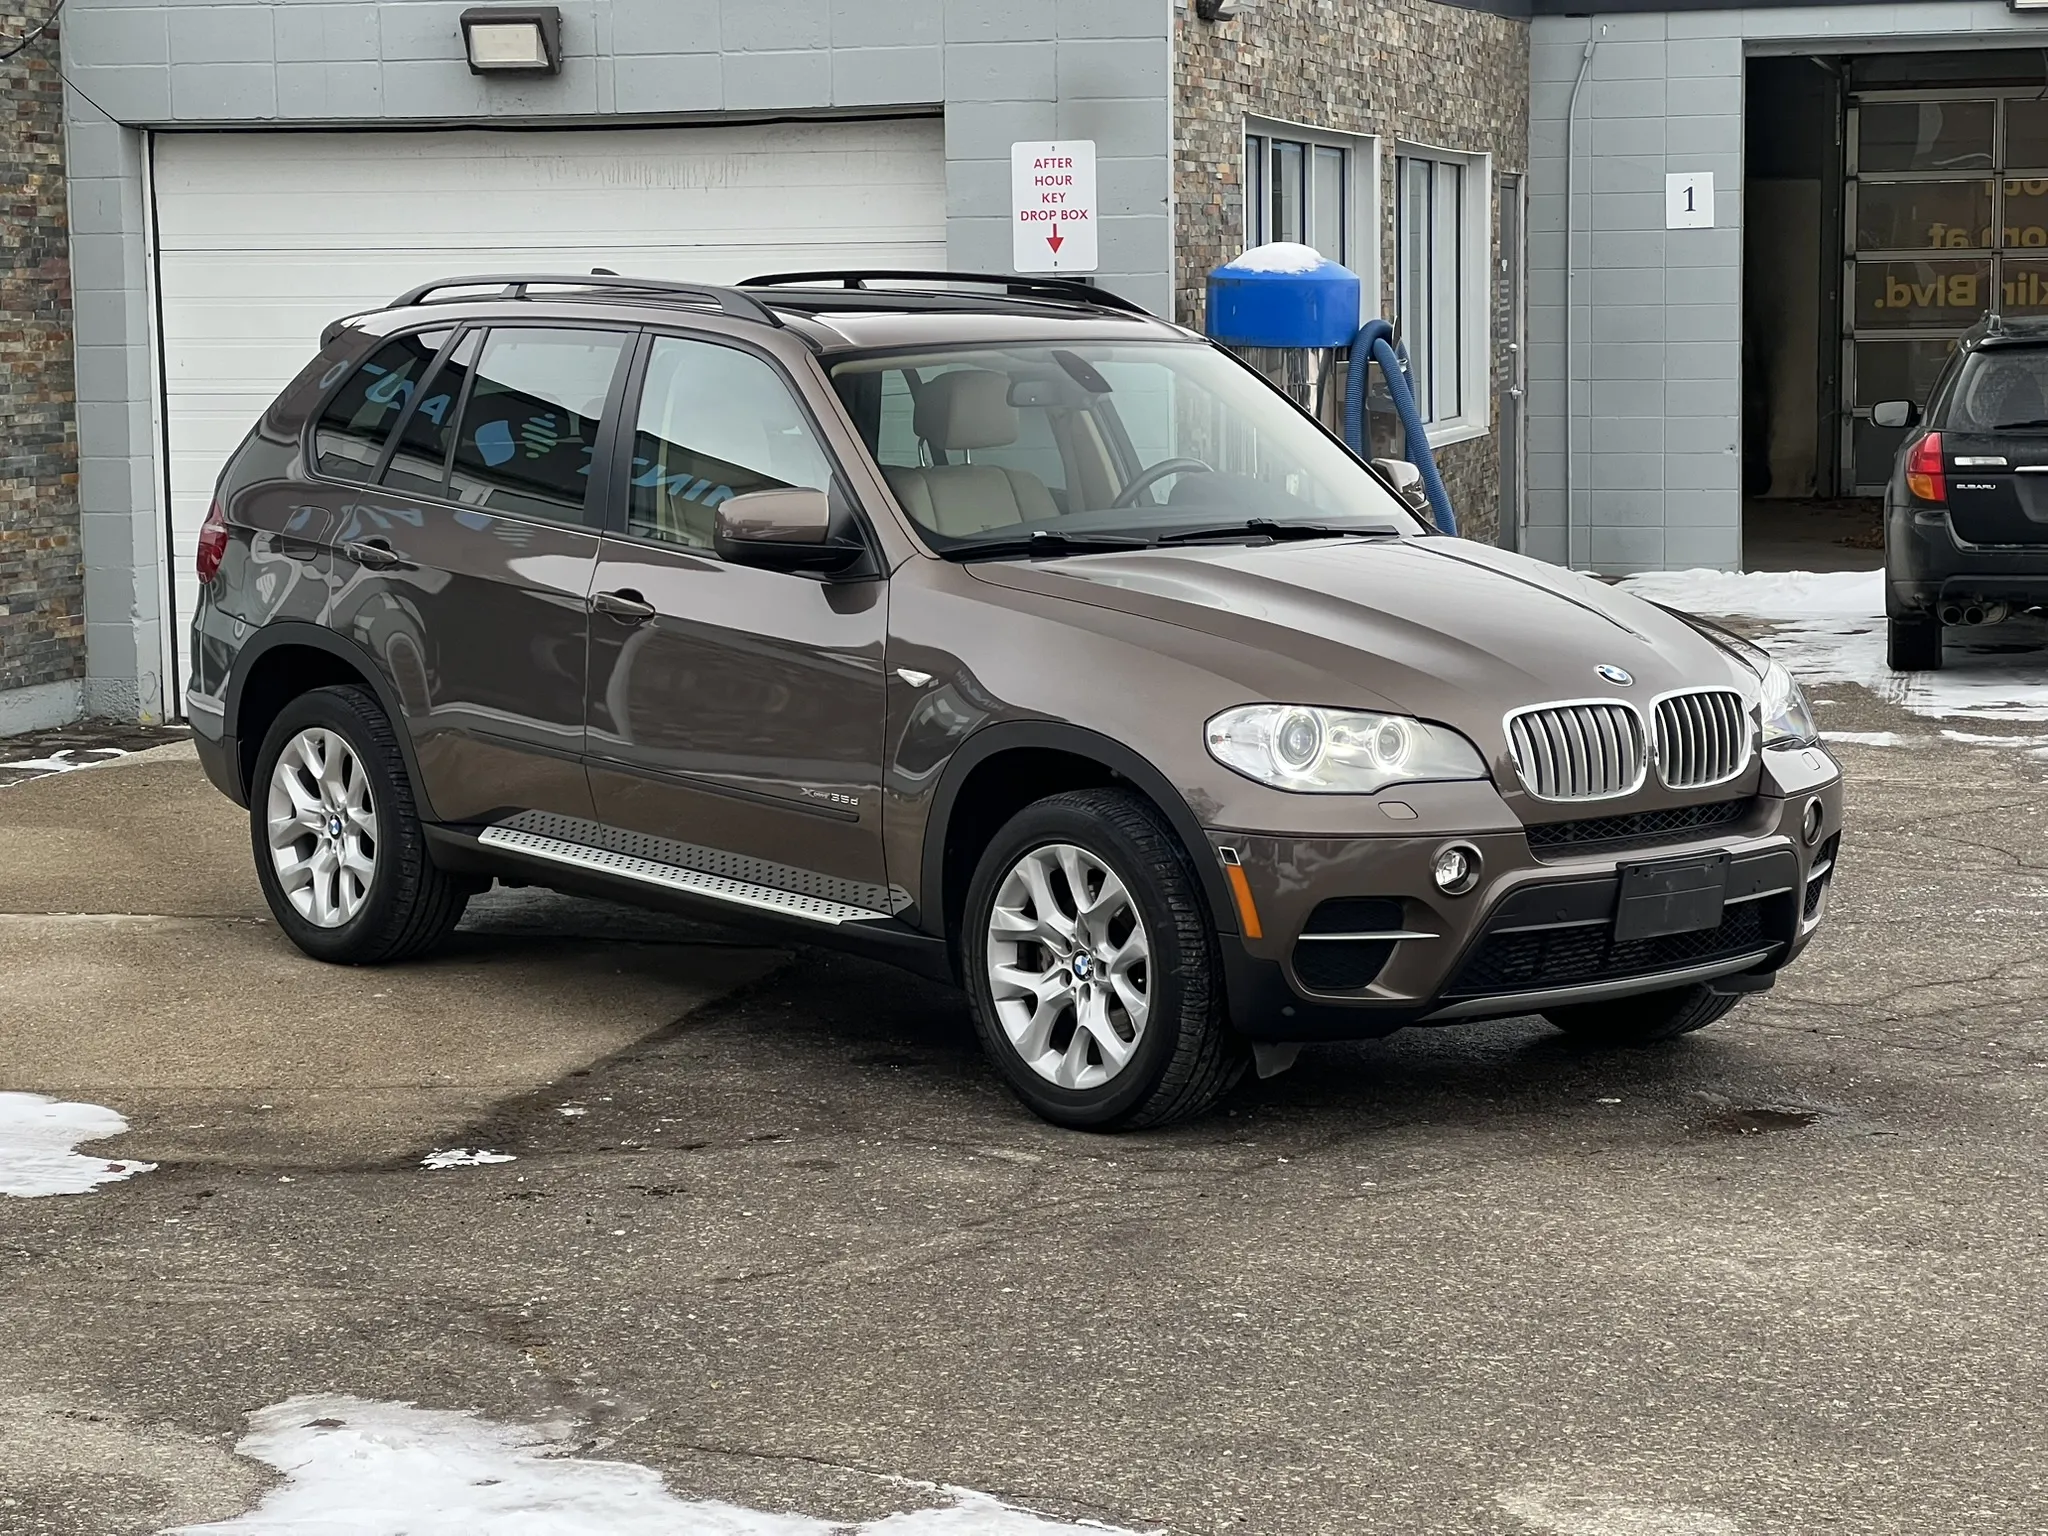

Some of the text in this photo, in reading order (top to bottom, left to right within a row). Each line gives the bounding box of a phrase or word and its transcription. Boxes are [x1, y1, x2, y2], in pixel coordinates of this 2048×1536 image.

[1033, 157, 1073, 169] AFTER
[1034, 175, 1073, 186] HOUR
[1041, 192, 1066, 203] KEY
[1682, 186, 1697, 212] 1
[1020, 209, 1088, 221] DROP BOX
